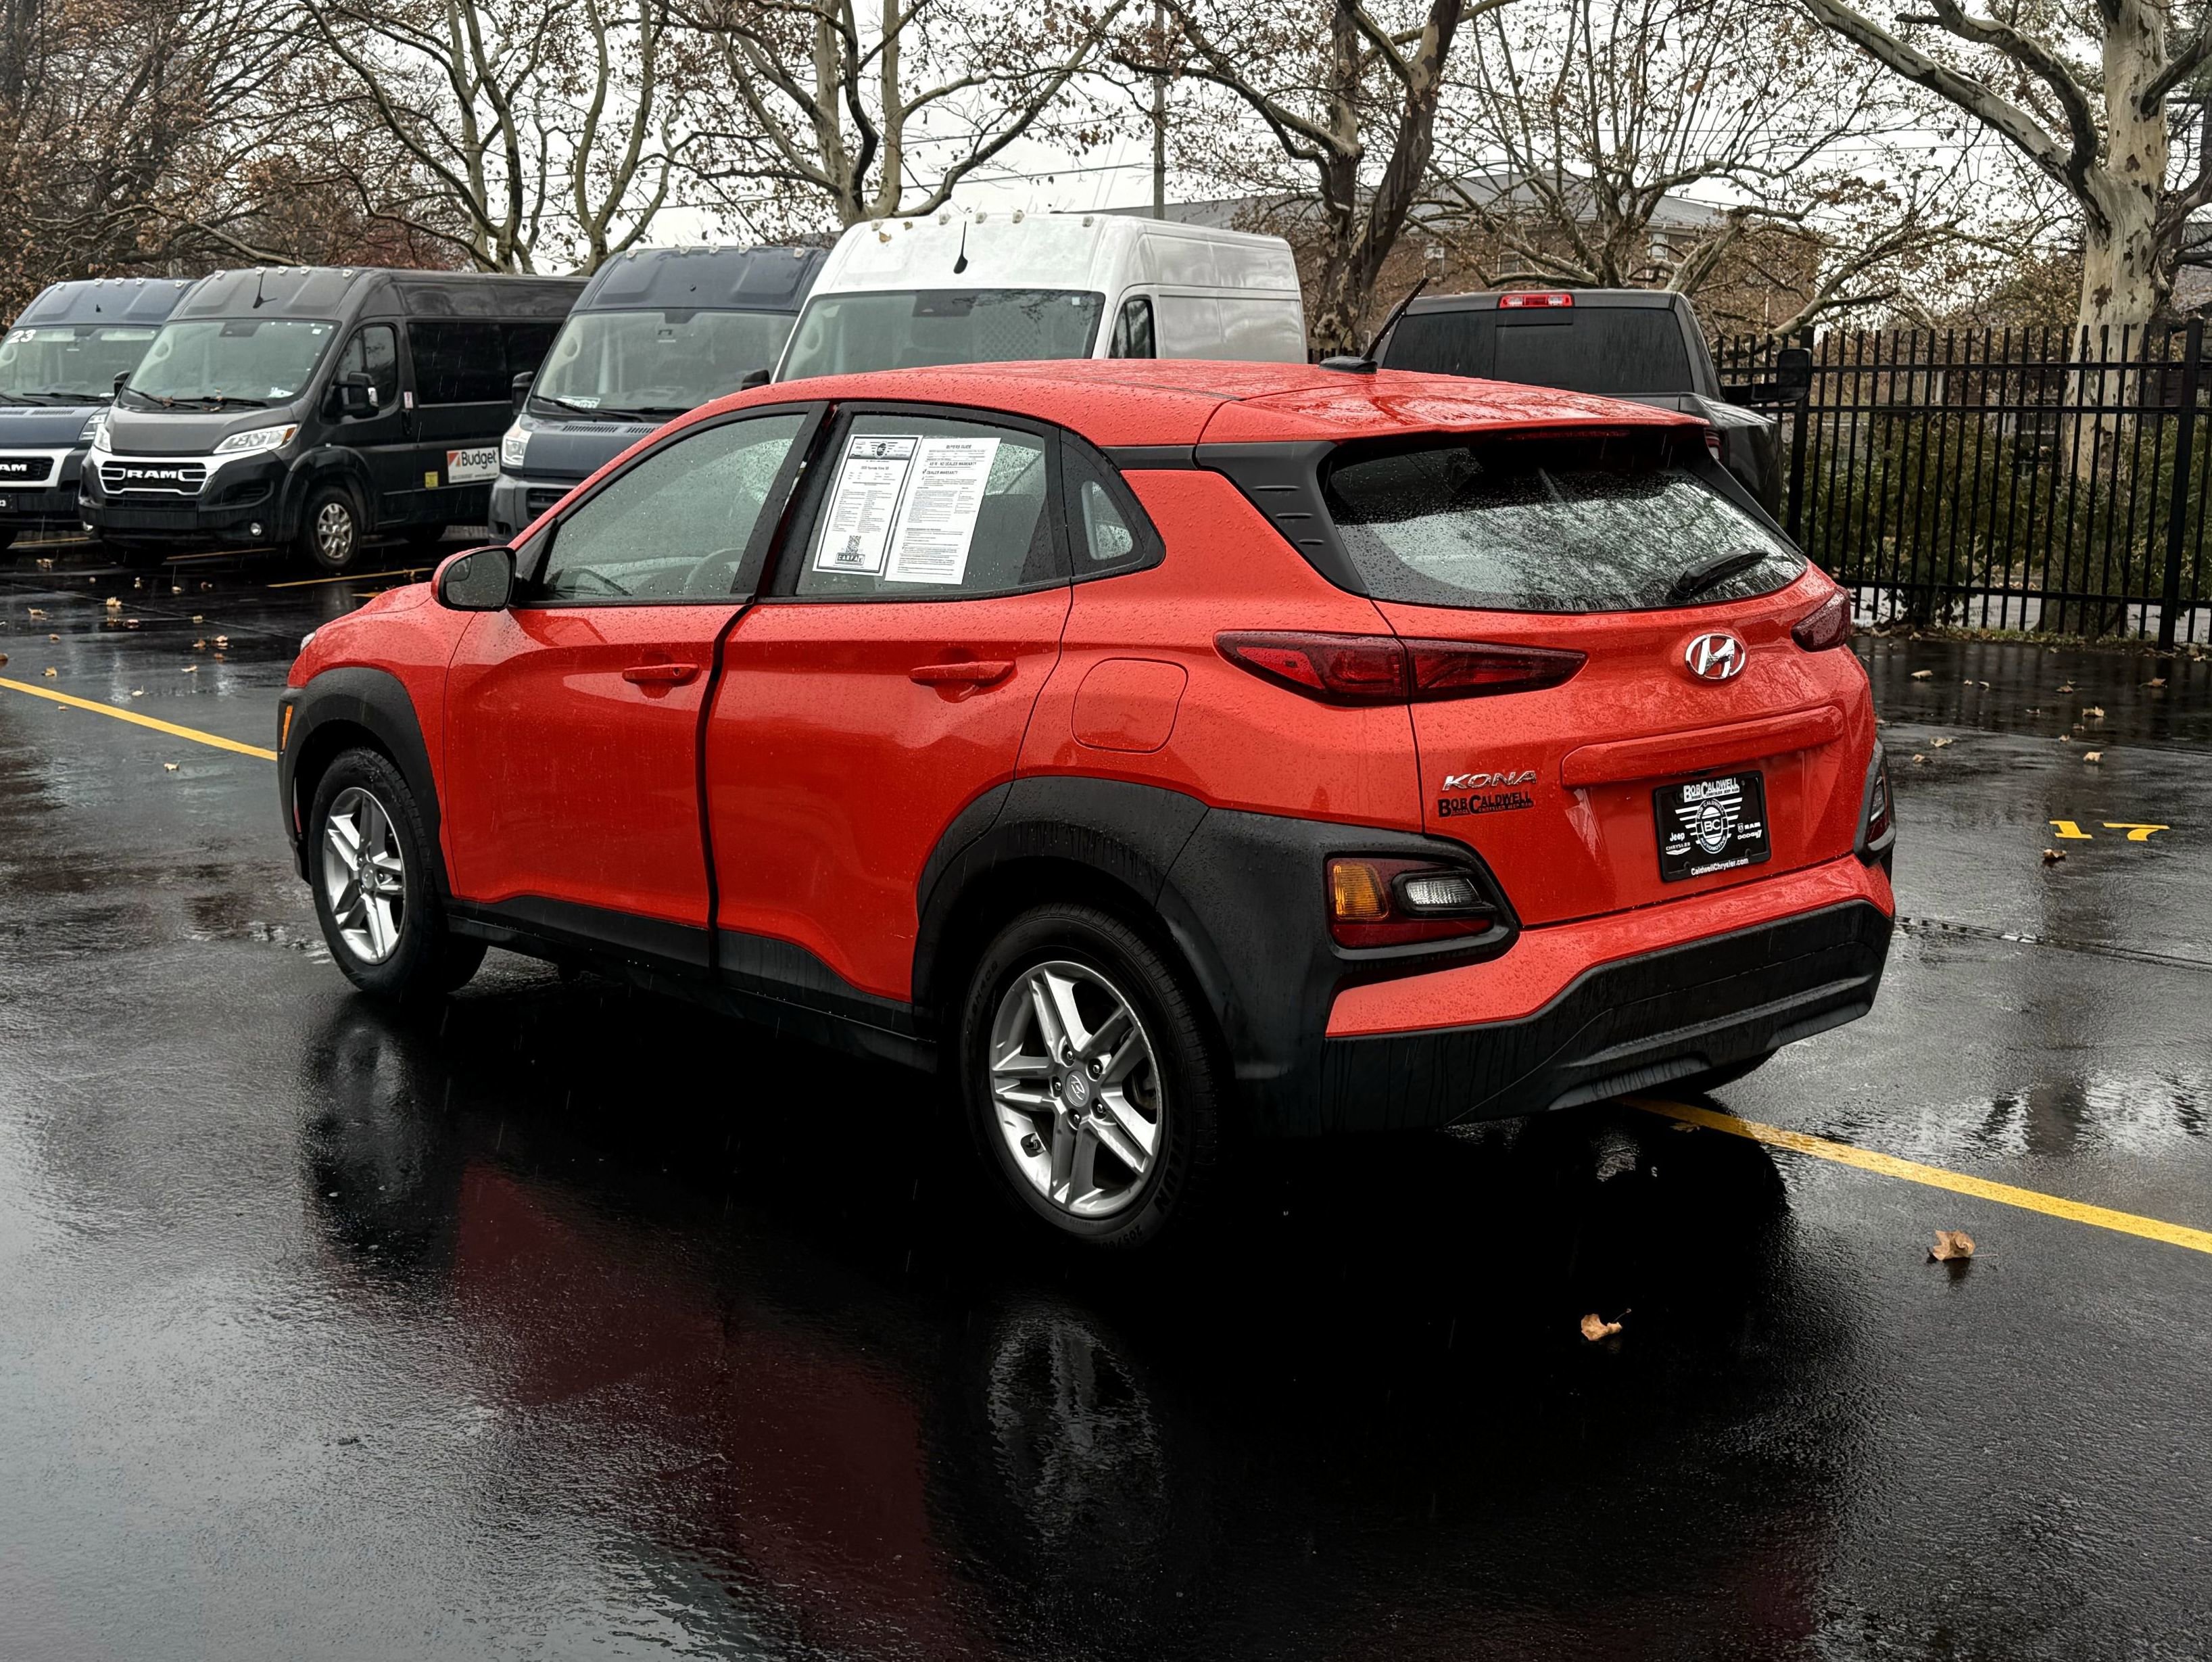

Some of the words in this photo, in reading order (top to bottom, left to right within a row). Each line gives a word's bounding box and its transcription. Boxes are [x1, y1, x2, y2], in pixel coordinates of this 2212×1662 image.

[7, 329, 37, 343] 23
[461, 449, 497, 469] Budget
[0, 464, 27, 472] AM
[127, 469, 177, 479] RAM
[1441, 770, 1537, 791] KONA
[1683, 784, 1701, 803] BOB
[1701, 777, 1739, 799] CALDWELL
[1438, 798, 1468, 817] BOB
[1468, 791, 1533, 814] CALDWELL
[1704, 819, 1721, 832] BC
[1745, 822, 1761, 830] RAM
[2049, 820, 2170, 841] 17
[1670, 832, 1685, 842] Jeep
[1666, 842, 1691, 851] CHRYSLER
[1691, 858, 1749, 876] CaldwellChrysler.com
